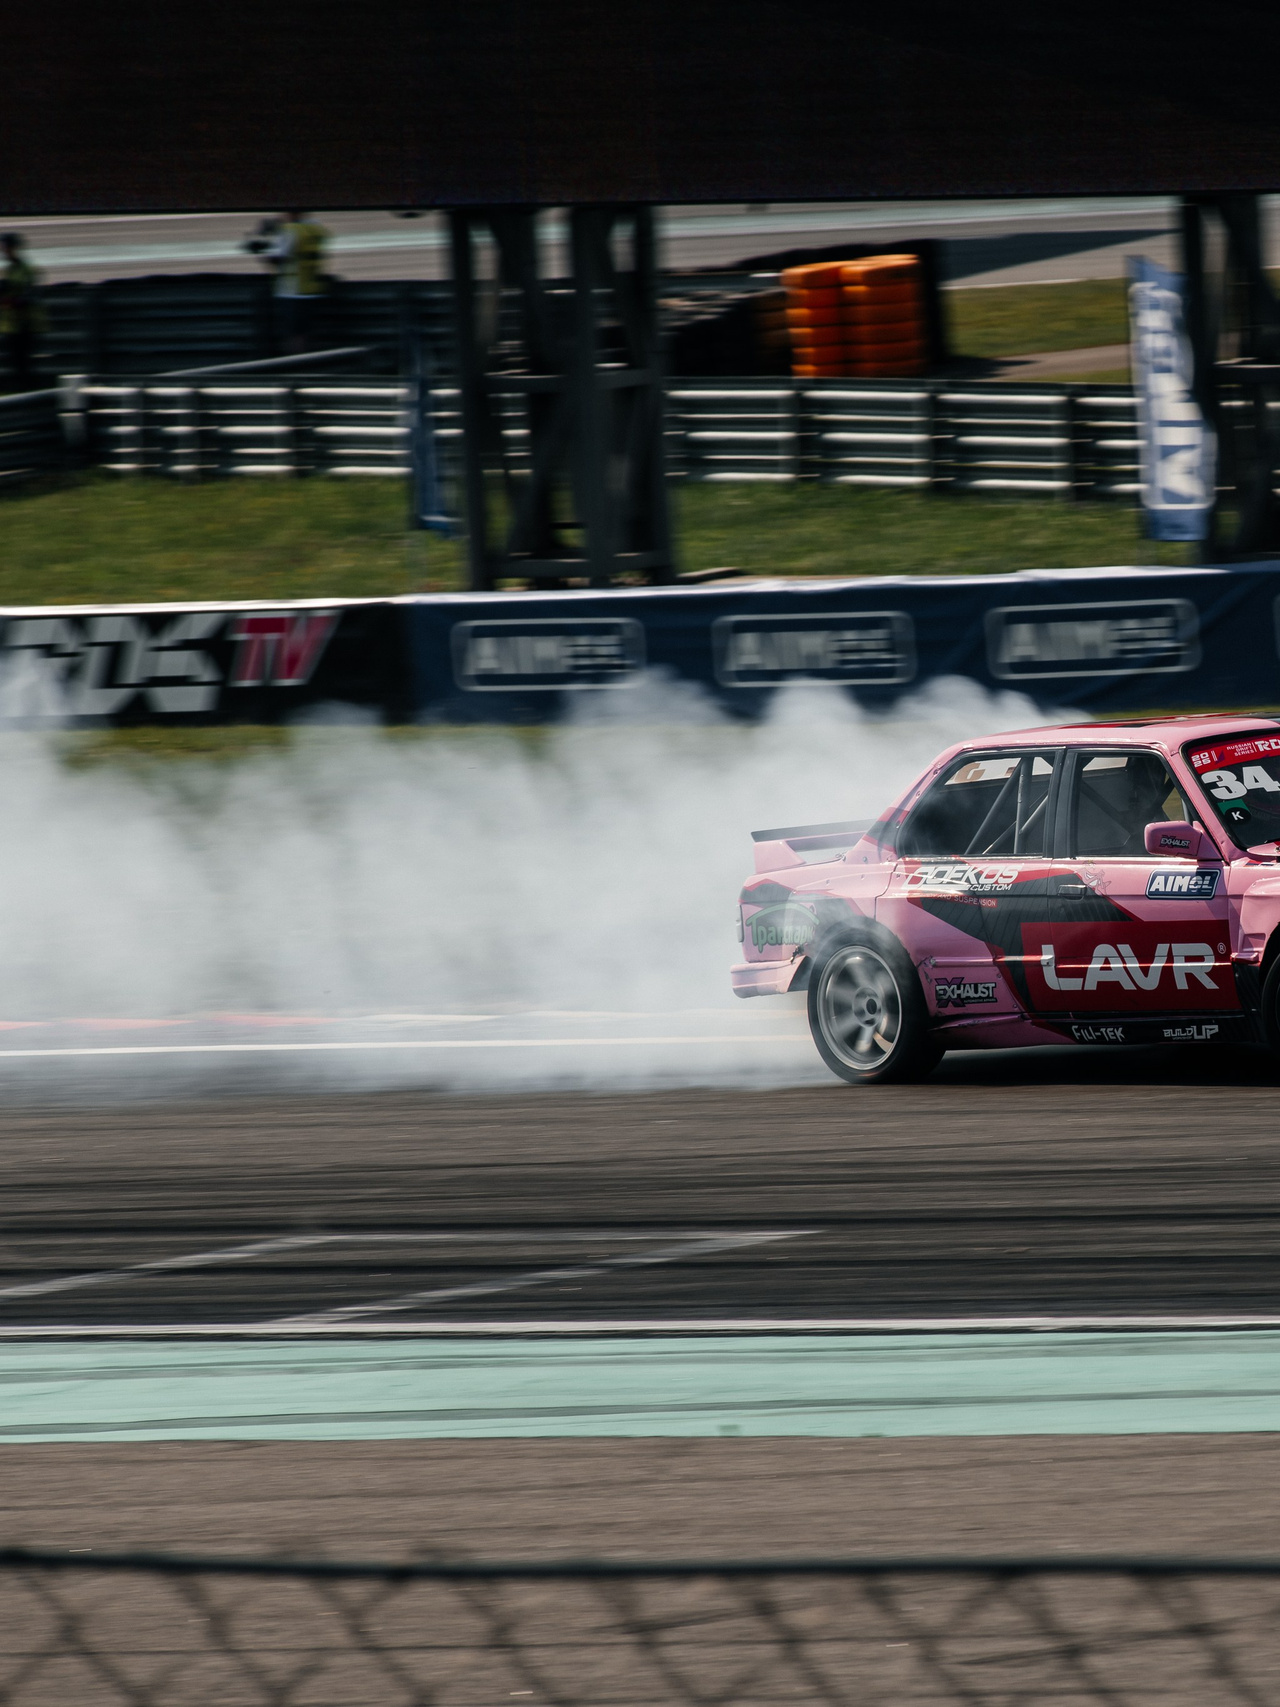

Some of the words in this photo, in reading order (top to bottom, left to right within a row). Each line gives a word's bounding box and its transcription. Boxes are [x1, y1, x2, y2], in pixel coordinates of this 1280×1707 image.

[227, 609, 341, 687] TV
[1201, 765, 1280, 800] 34
[1231, 811, 1244, 821] K
[1160, 837, 1191, 847] EXHAUST
[970, 883, 1012, 891] CUSTOM
[1149, 875, 1213, 893] AIMOL
[1040, 942, 1220, 991] LAVR
[935, 981, 996, 1000] EXHAUST
[1192, 1024, 1219, 1039] UP
